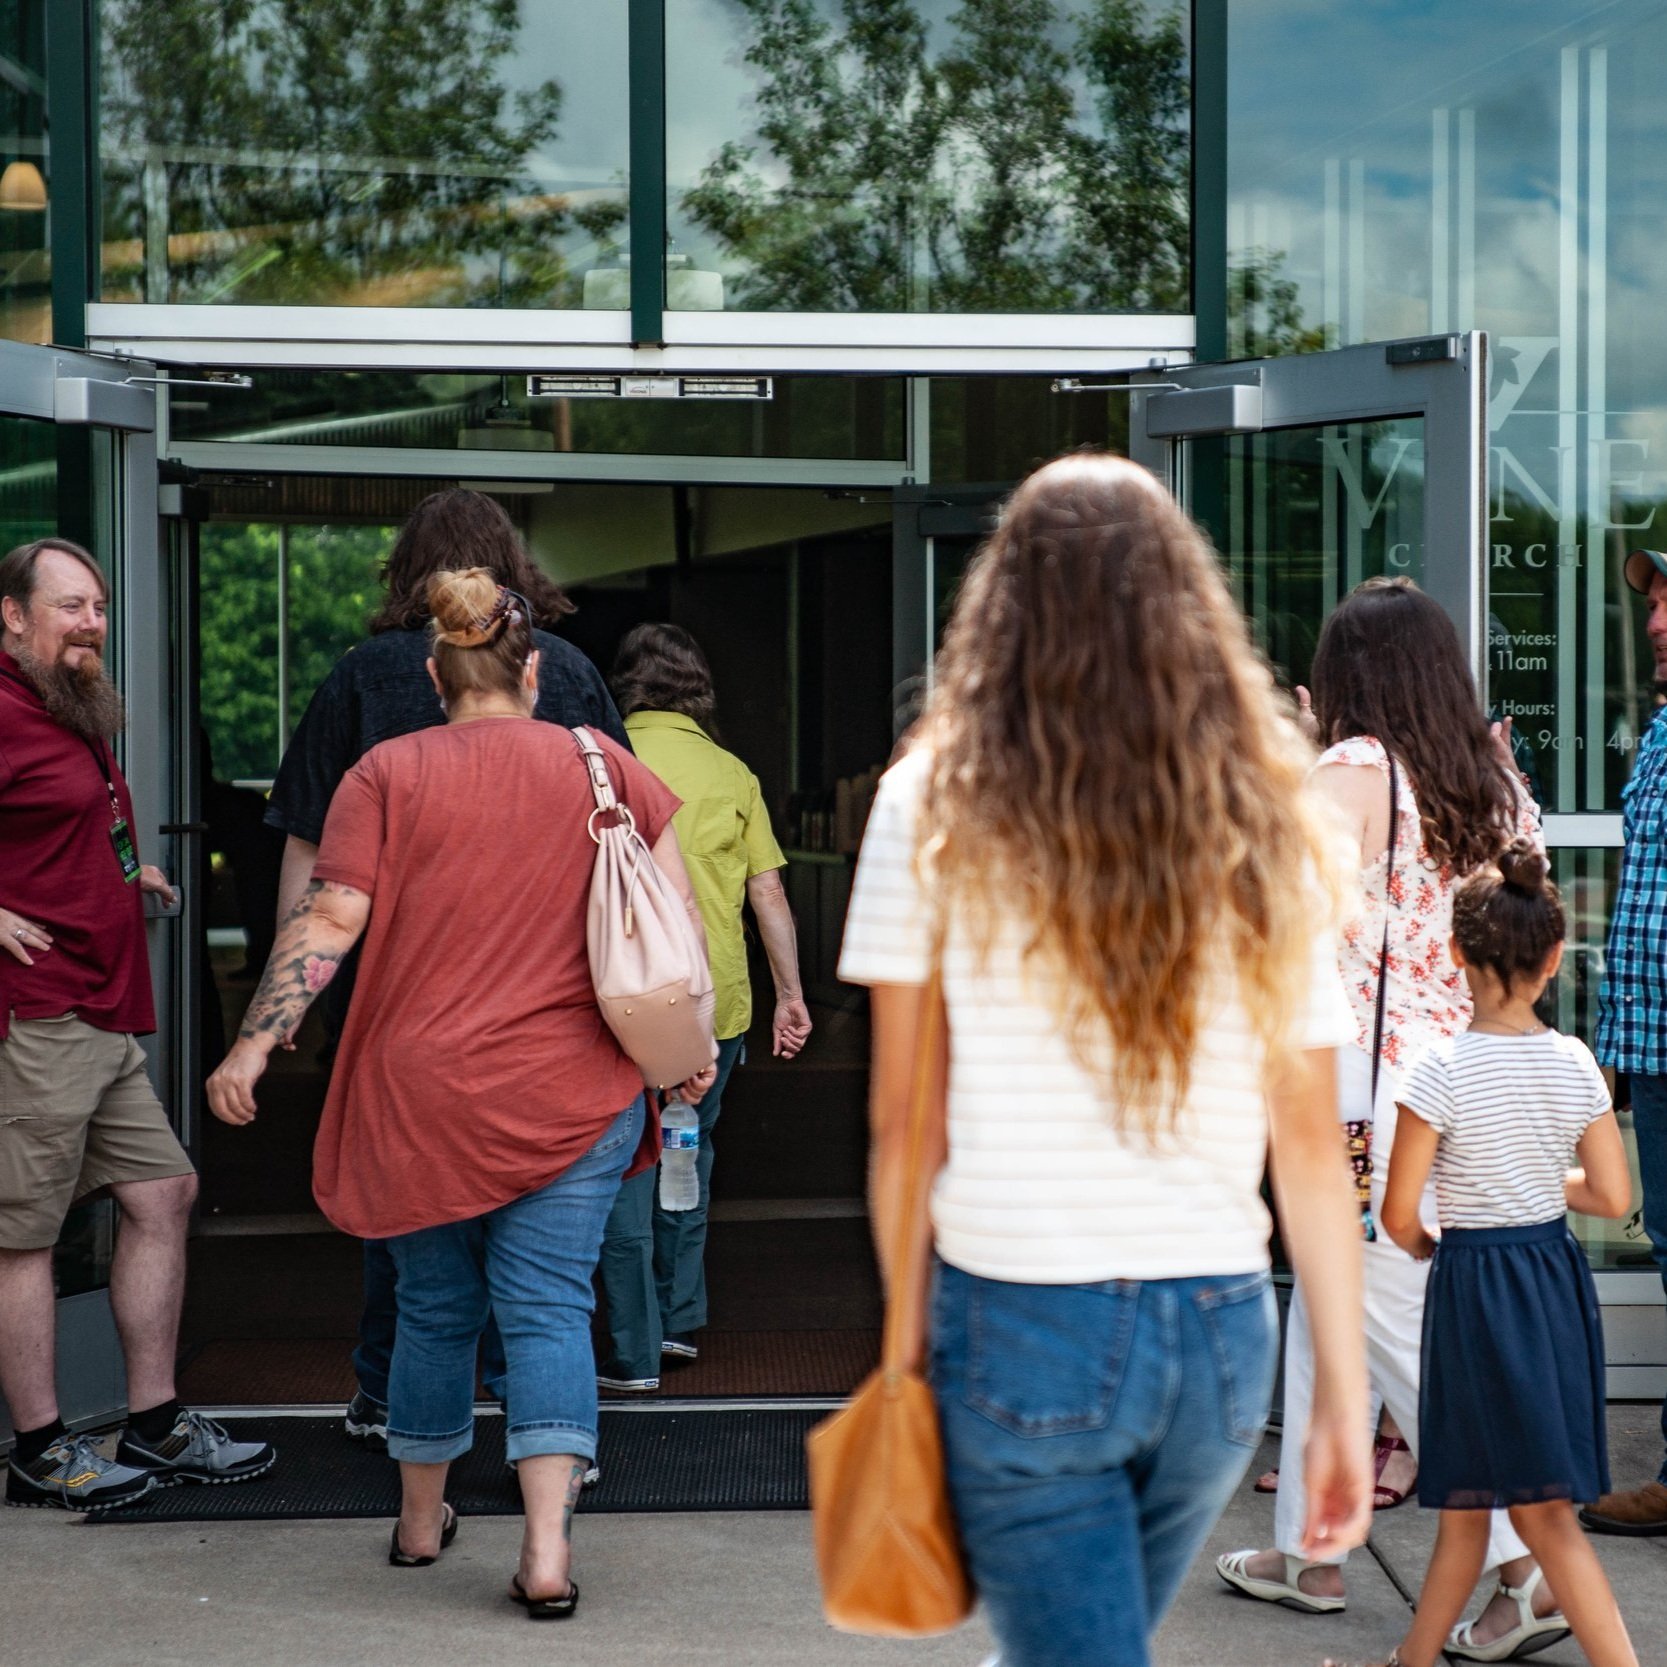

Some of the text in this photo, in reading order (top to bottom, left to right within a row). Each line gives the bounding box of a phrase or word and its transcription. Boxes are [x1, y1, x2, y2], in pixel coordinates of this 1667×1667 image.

[1316, 438, 1657, 530] VNE
[1388, 543, 1583, 568] CRCH
[1497, 650, 1547, 671] 11am
[1502, 699, 1555, 716] Hours:
[1538, 729, 1584, 750] 9am
